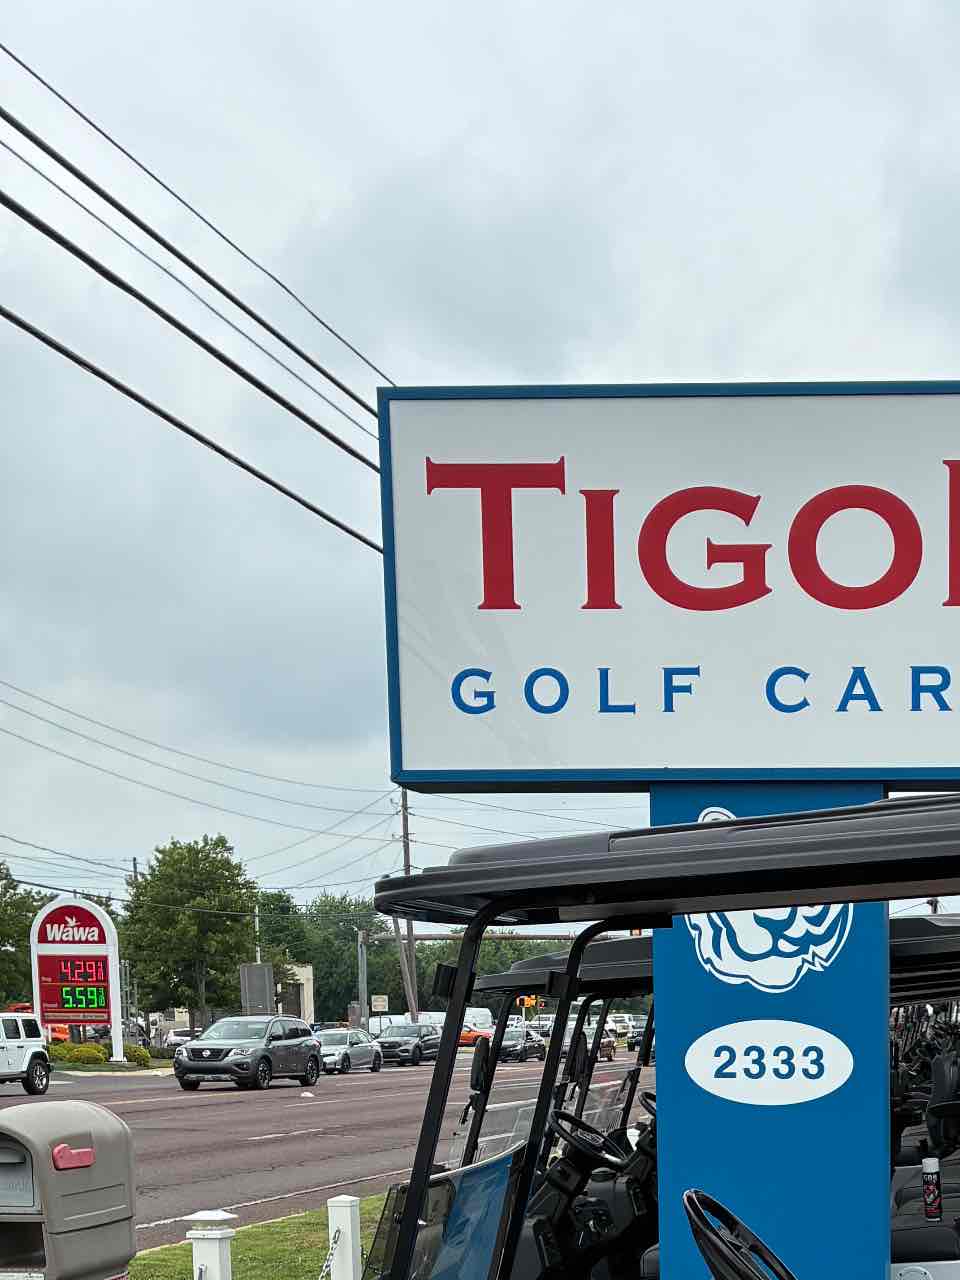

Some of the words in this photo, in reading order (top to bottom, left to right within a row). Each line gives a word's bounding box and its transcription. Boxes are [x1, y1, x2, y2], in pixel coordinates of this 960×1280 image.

[451, 666, 700, 715] GOLF
[46, 923, 98, 942] Wawa
[713, 1045, 825, 1080] 2333
